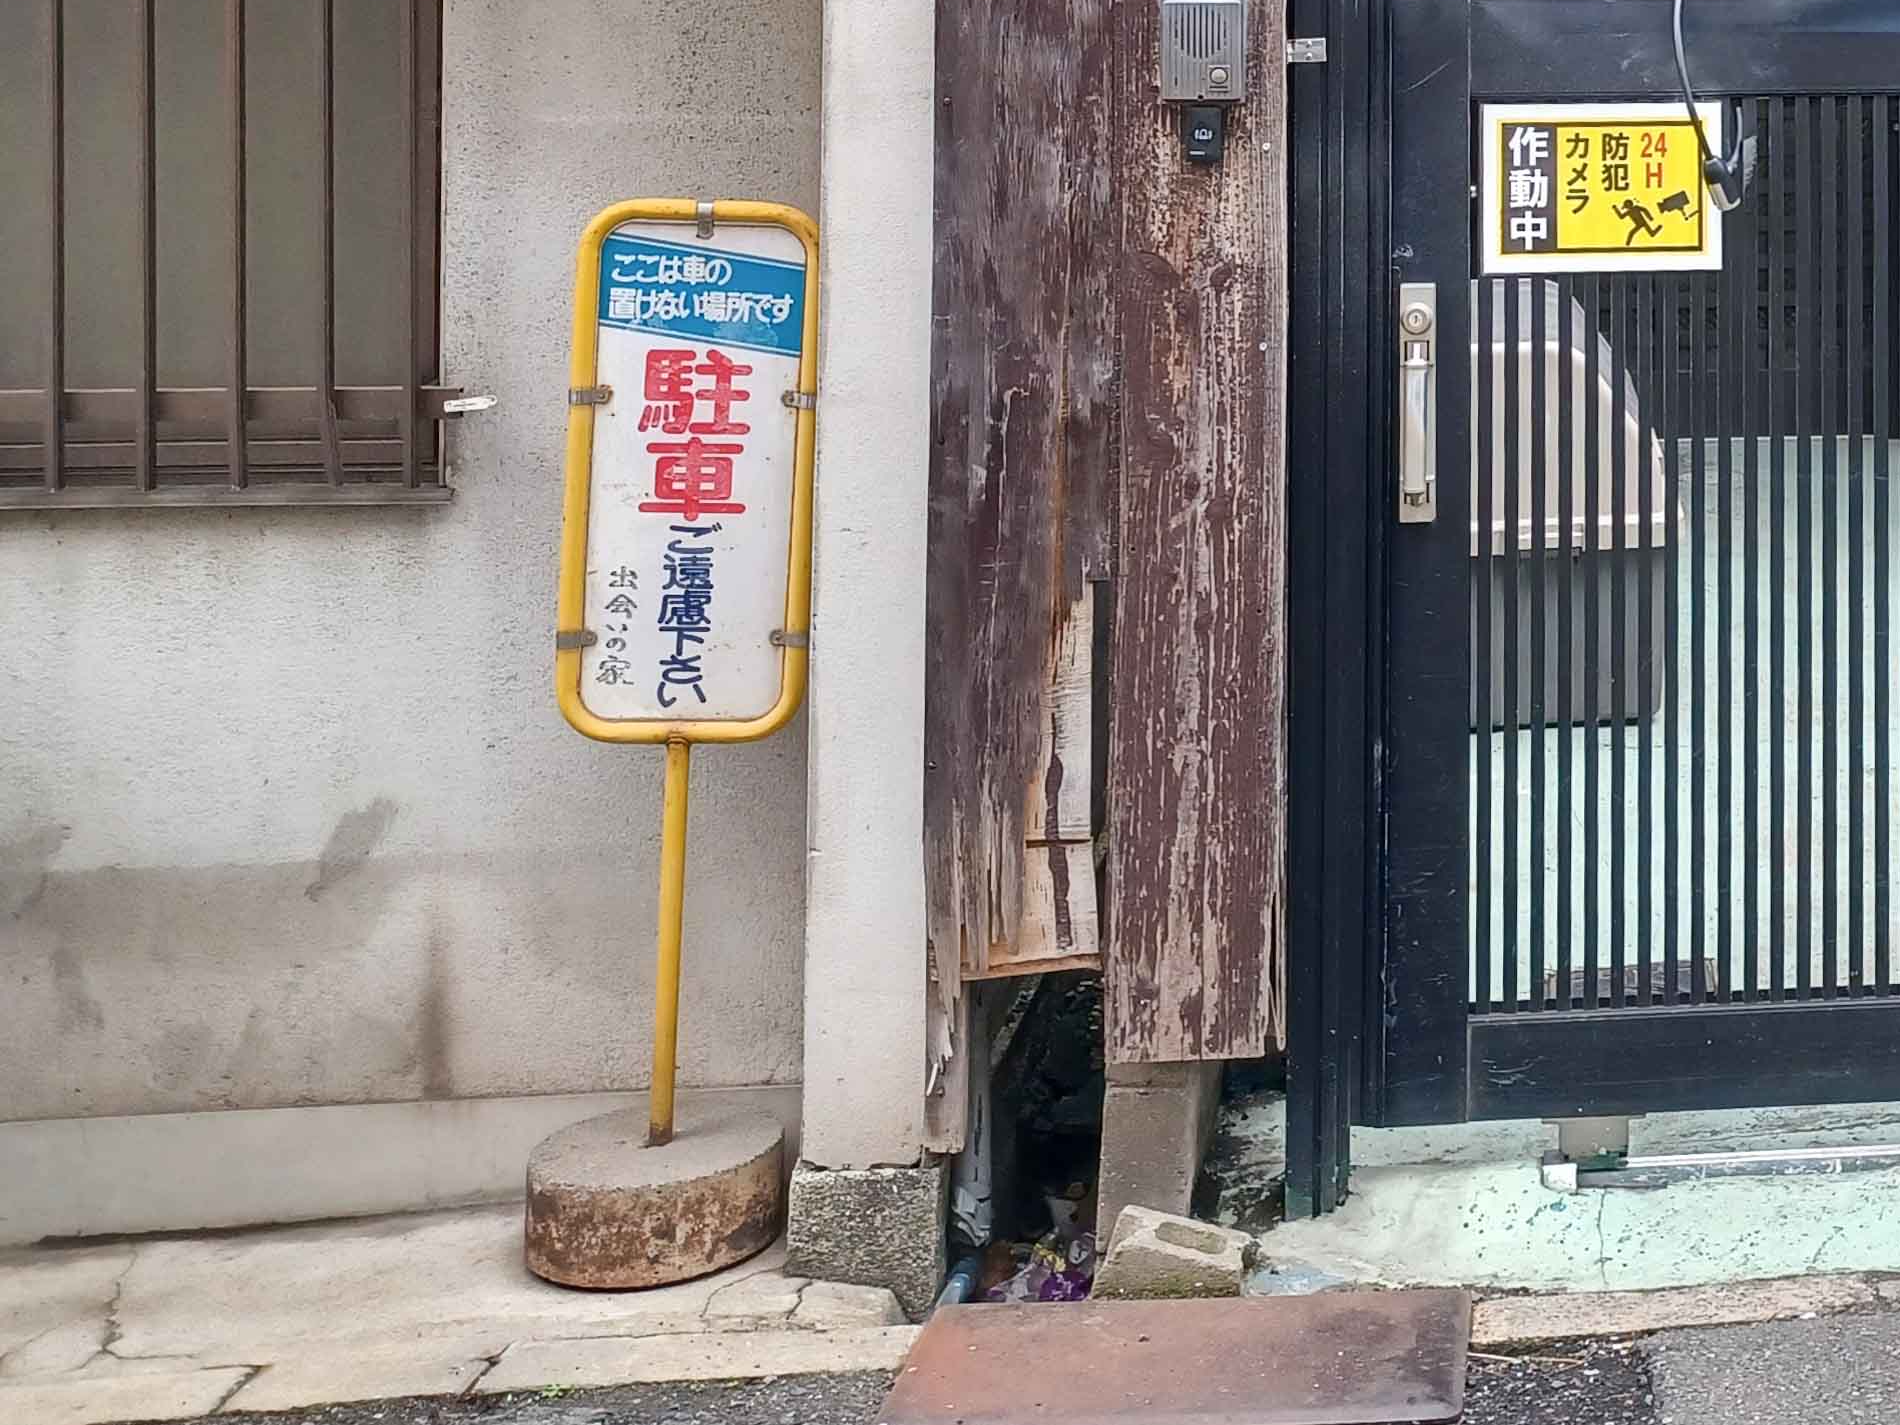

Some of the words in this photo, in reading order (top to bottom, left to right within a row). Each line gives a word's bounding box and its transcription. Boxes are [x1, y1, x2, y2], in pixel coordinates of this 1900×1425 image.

[1508, 126, 1549, 251] 作動中
[1565, 133, 1590, 214] カメラ
[1601, 133, 1630, 191] 防犯
[608, 287, 794, 325] 置けない場所です
[611, 253, 732, 287] ここは車の
[637, 348, 754, 522] 駐車
[595, 565, 640, 687] 出会いの家
[656, 524, 723, 708] ご遠慮下さい
